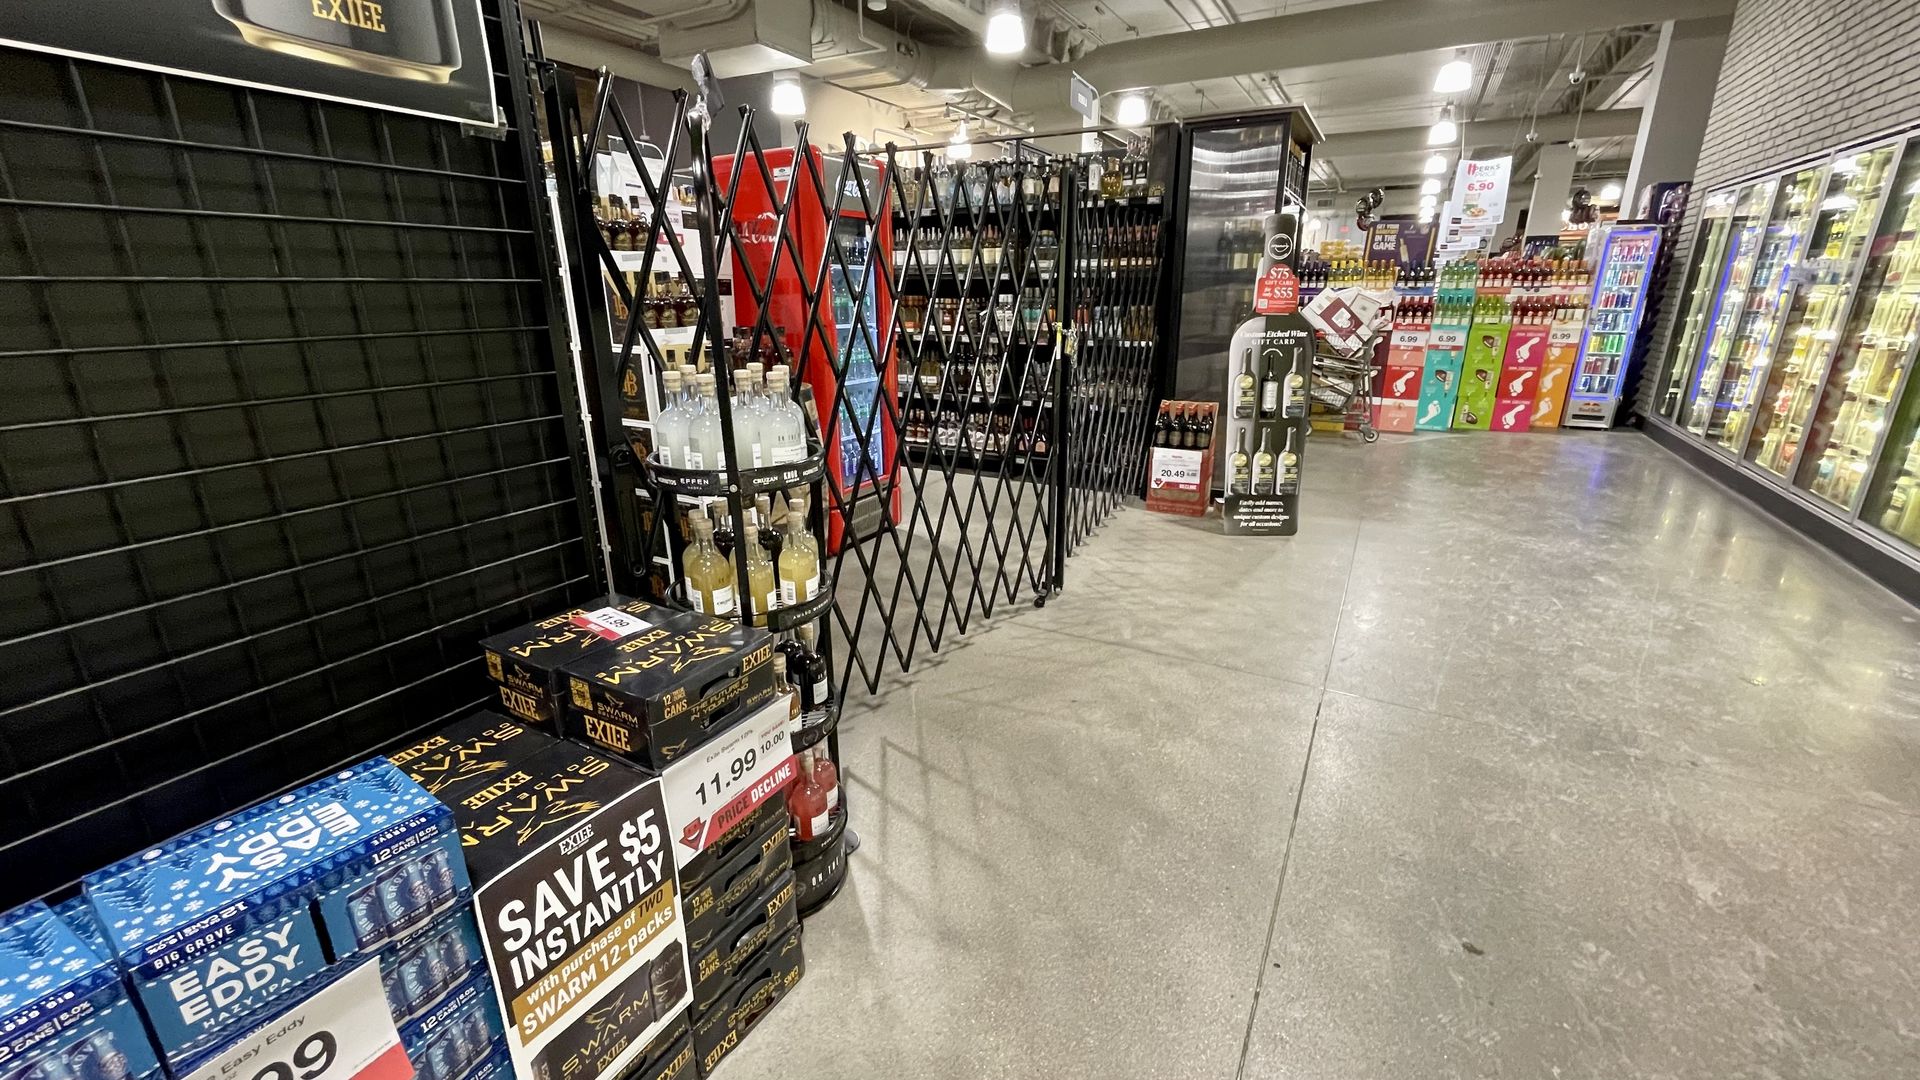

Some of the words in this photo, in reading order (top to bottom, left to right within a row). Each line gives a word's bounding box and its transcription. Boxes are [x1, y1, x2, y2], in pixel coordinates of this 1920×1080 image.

[312, 0, 387, 33] EXILE
[1467, 181, 1495, 192] 6.90
[1373, 241, 1397, 250] GAME
[1269, 266, 1290, 280] $75
[1273, 286, 1294, 299] $55
[1266, 330, 1290, 338] Etched
[1290, 330, 1308, 338] Wine
[1400, 335, 1418, 343] 6.99
[1438, 335, 1456, 343] 6.99
[1552, 332, 1571, 340] 6.99
[680, 477, 709, 485] EFFEN
[753, 476, 778, 484] CRUZAN
[1161, 469, 1185, 478] 20.49
[596, 613, 630, 628] 11.99
[603, 621, 735, 685] SWARM
[617, 629, 672, 653] EXILE
[742, 643, 772, 673] EXILE
[506, 674, 543, 695] SWARM
[499, 685, 542, 721] EXILE
[662, 694, 671, 707] 12
[664, 699, 688, 719] CANS
[702, 697, 725, 715] YOUR
[726, 682, 750, 700] HAND
[596, 701, 639, 725] SWARM
[584, 714, 632, 752] EXILE
[760, 730, 785, 754] 10.00
[695, 748, 757, 806] 11.99
[460, 770, 534, 811] EXILE
[717, 796, 749, 829] PRICE
[750, 762, 792, 804] DECLINE
[205, 802, 349, 876] EDDY
[392, 840, 416, 855] CANS
[558, 823, 595, 856] EXILE
[762, 825, 788, 857] EXILE
[216, 814, 362, 892] EASY
[371, 848, 393, 866] 12
[498, 838, 617, 952] SAVE
[618, 808, 662, 867] $5
[218, 900, 249, 921] 12
[691, 896, 701, 908] 12
[693, 897, 714, 919] CANS
[767, 882, 794, 918] EXILE
[509, 850, 665, 989] INSTANTLY
[153, 950, 180, 971] BIG
[185, 923, 236, 954] GROVE
[527, 975, 560, 1006] with
[562, 925, 622, 983] purchase
[623, 909, 636, 930] of
[638, 888, 664, 918] TWO
[168, 921, 294, 1002] EASY
[522, 964, 598, 1036] SWARM
[599, 905, 673, 972] 12-packs
[700, 958, 721, 981] CANS
[179, 943, 301, 1026] EDDY
[784, 965, 799, 987] CANS
[203, 996, 254, 1030] HAZY
[262, 977, 292, 997] IPA
[438, 1004, 459, 1021] CANS
[420, 1014, 439, 1034] 12
[562, 990, 650, 1077] SWARM
[14, 1026, 56, 1053] CANS
[220, 1044, 262, 1076] Easy
[265, 1014, 307, 1047] Eddy
[704, 1029, 739, 1072] EXILE
[597, 1035, 629, 1073] EXILE
